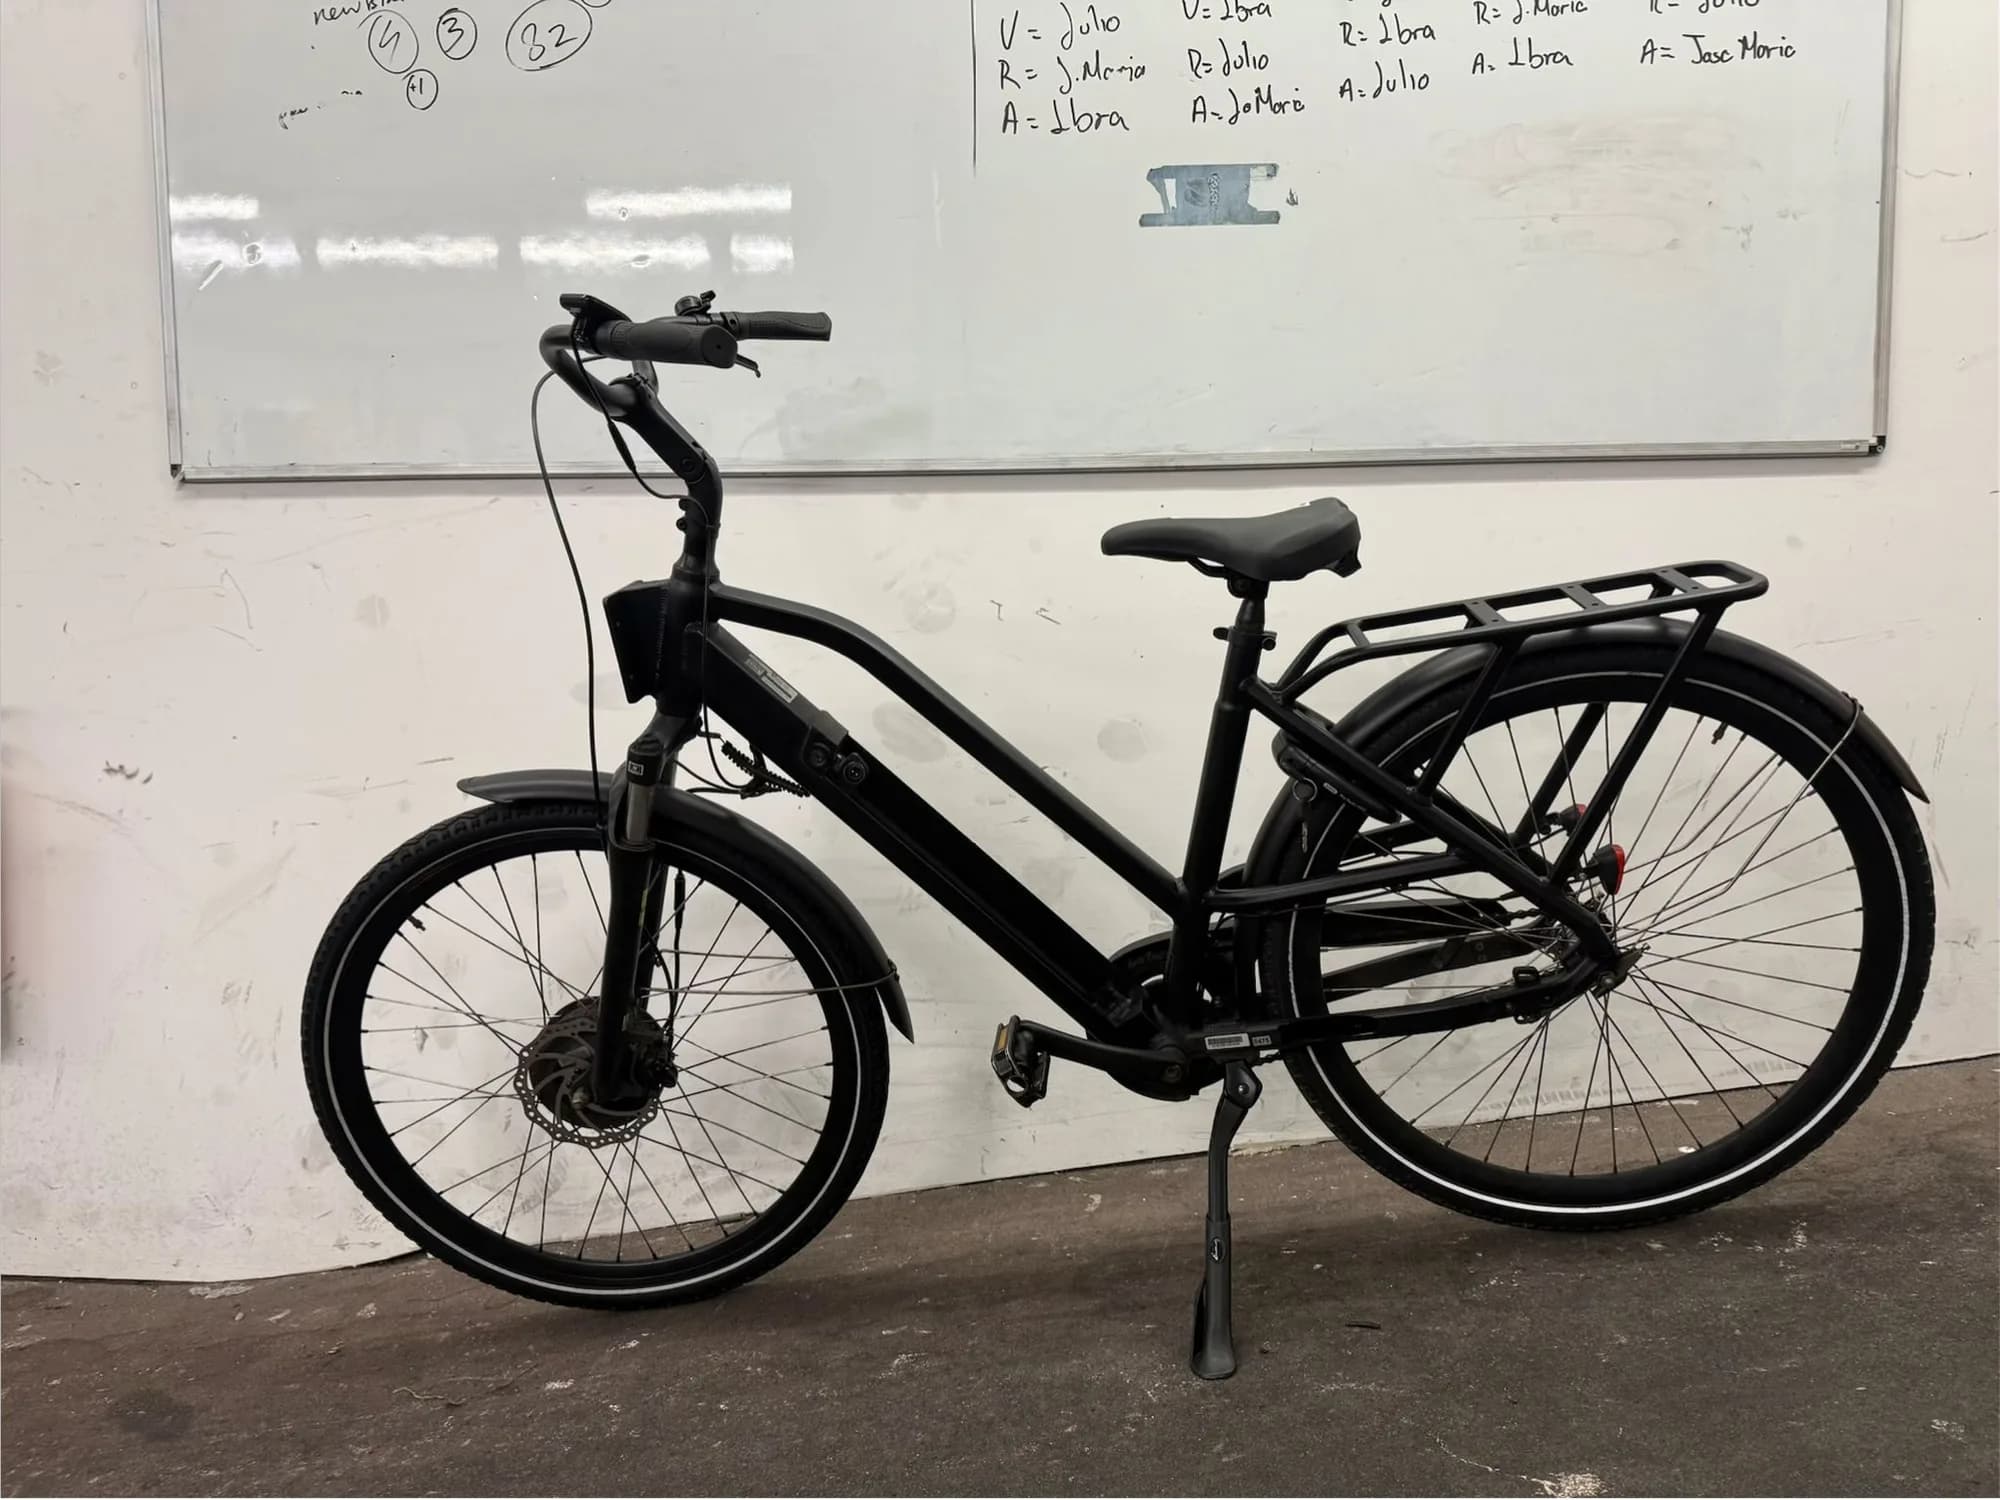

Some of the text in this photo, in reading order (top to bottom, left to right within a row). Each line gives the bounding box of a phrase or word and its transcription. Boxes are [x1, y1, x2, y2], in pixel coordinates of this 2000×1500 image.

[442, 17, 464, 53] 3
[521, 22, 578, 62] 82
[1060, 2, 1121, 50] Julio
[1379, 13, 1436, 45] Ibra
[1218, 37, 1269, 77] Julio
[1508, 37, 1574, 69] Ibra
[1372, 58, 1430, 99] Julio
[1050, 97, 1130, 134] Ibra
